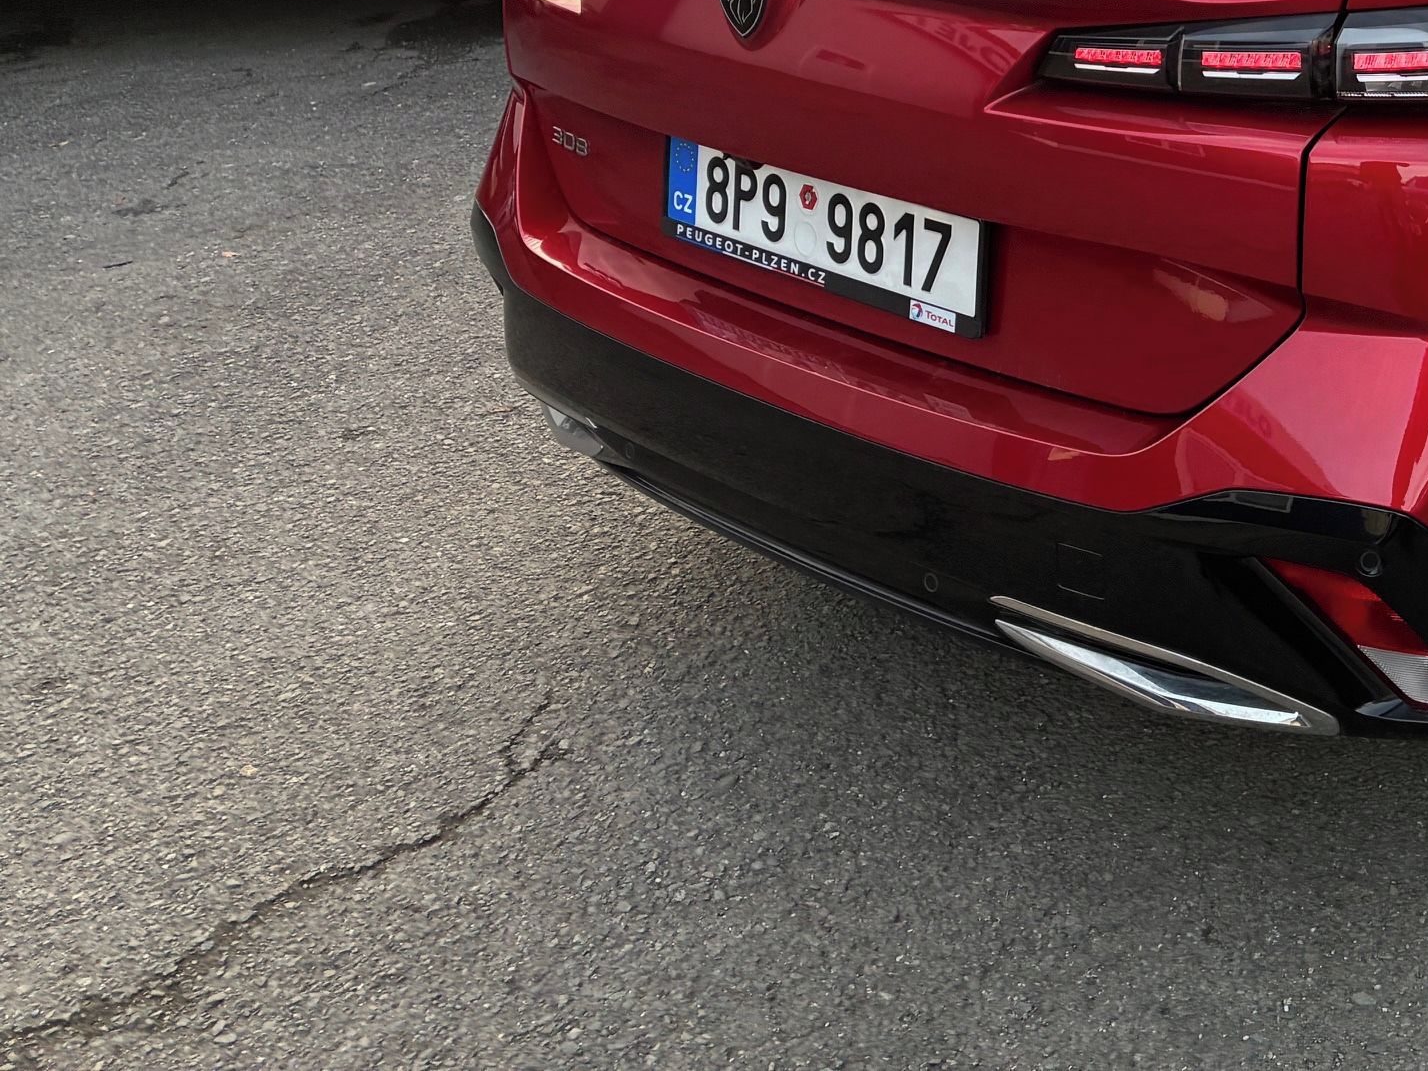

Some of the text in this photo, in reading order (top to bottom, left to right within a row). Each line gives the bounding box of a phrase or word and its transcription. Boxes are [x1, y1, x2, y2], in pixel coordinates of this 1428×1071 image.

[552, 125, 588, 157] 308
[673, 191, 693, 213] CZ
[705, 156, 952, 293] 8P9 9817
[676, 224, 826, 284] PEUGEOT-PLZEN.CZ
[925, 309, 954, 328] TOTAL
